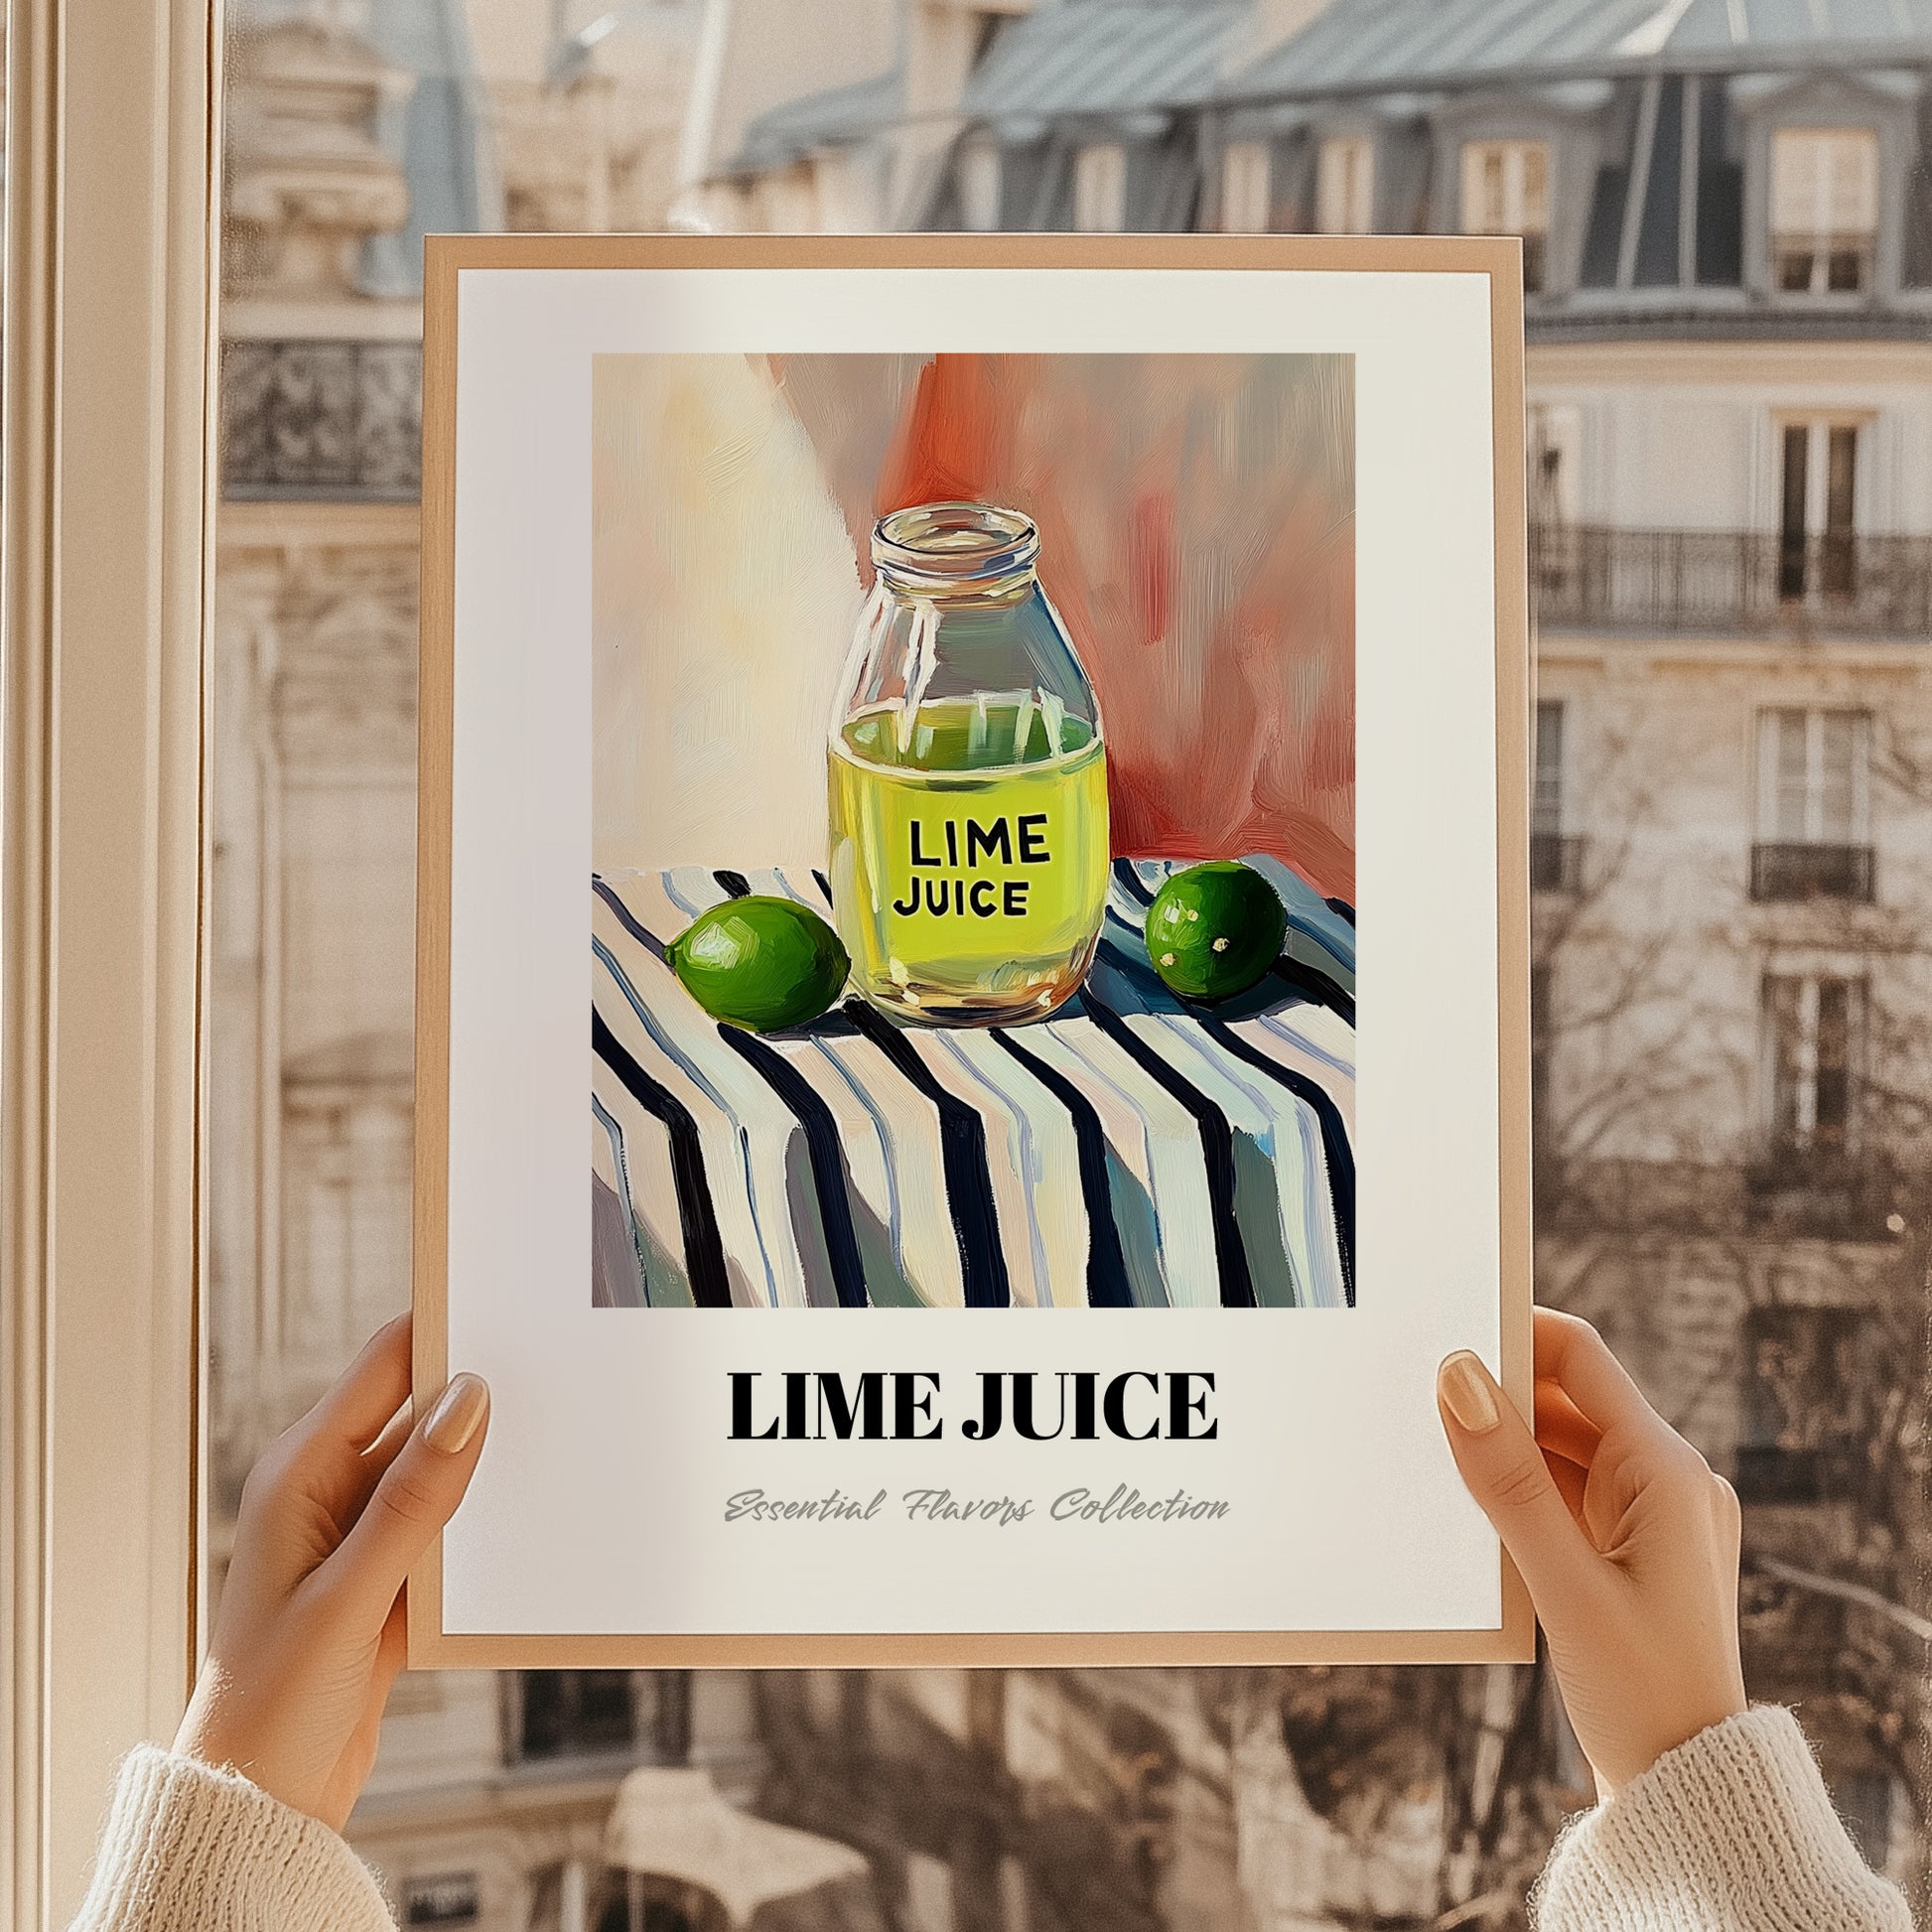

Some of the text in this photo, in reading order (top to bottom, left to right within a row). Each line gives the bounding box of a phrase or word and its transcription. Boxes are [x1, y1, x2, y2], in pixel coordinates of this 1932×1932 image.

[910, 813, 1050, 868] LIME
[893, 877, 1030, 918] JUICE
[727, 1371, 1218, 1441] LIME JUICE
[724, 1482, 1231, 1528] Essential Flavors Collection
